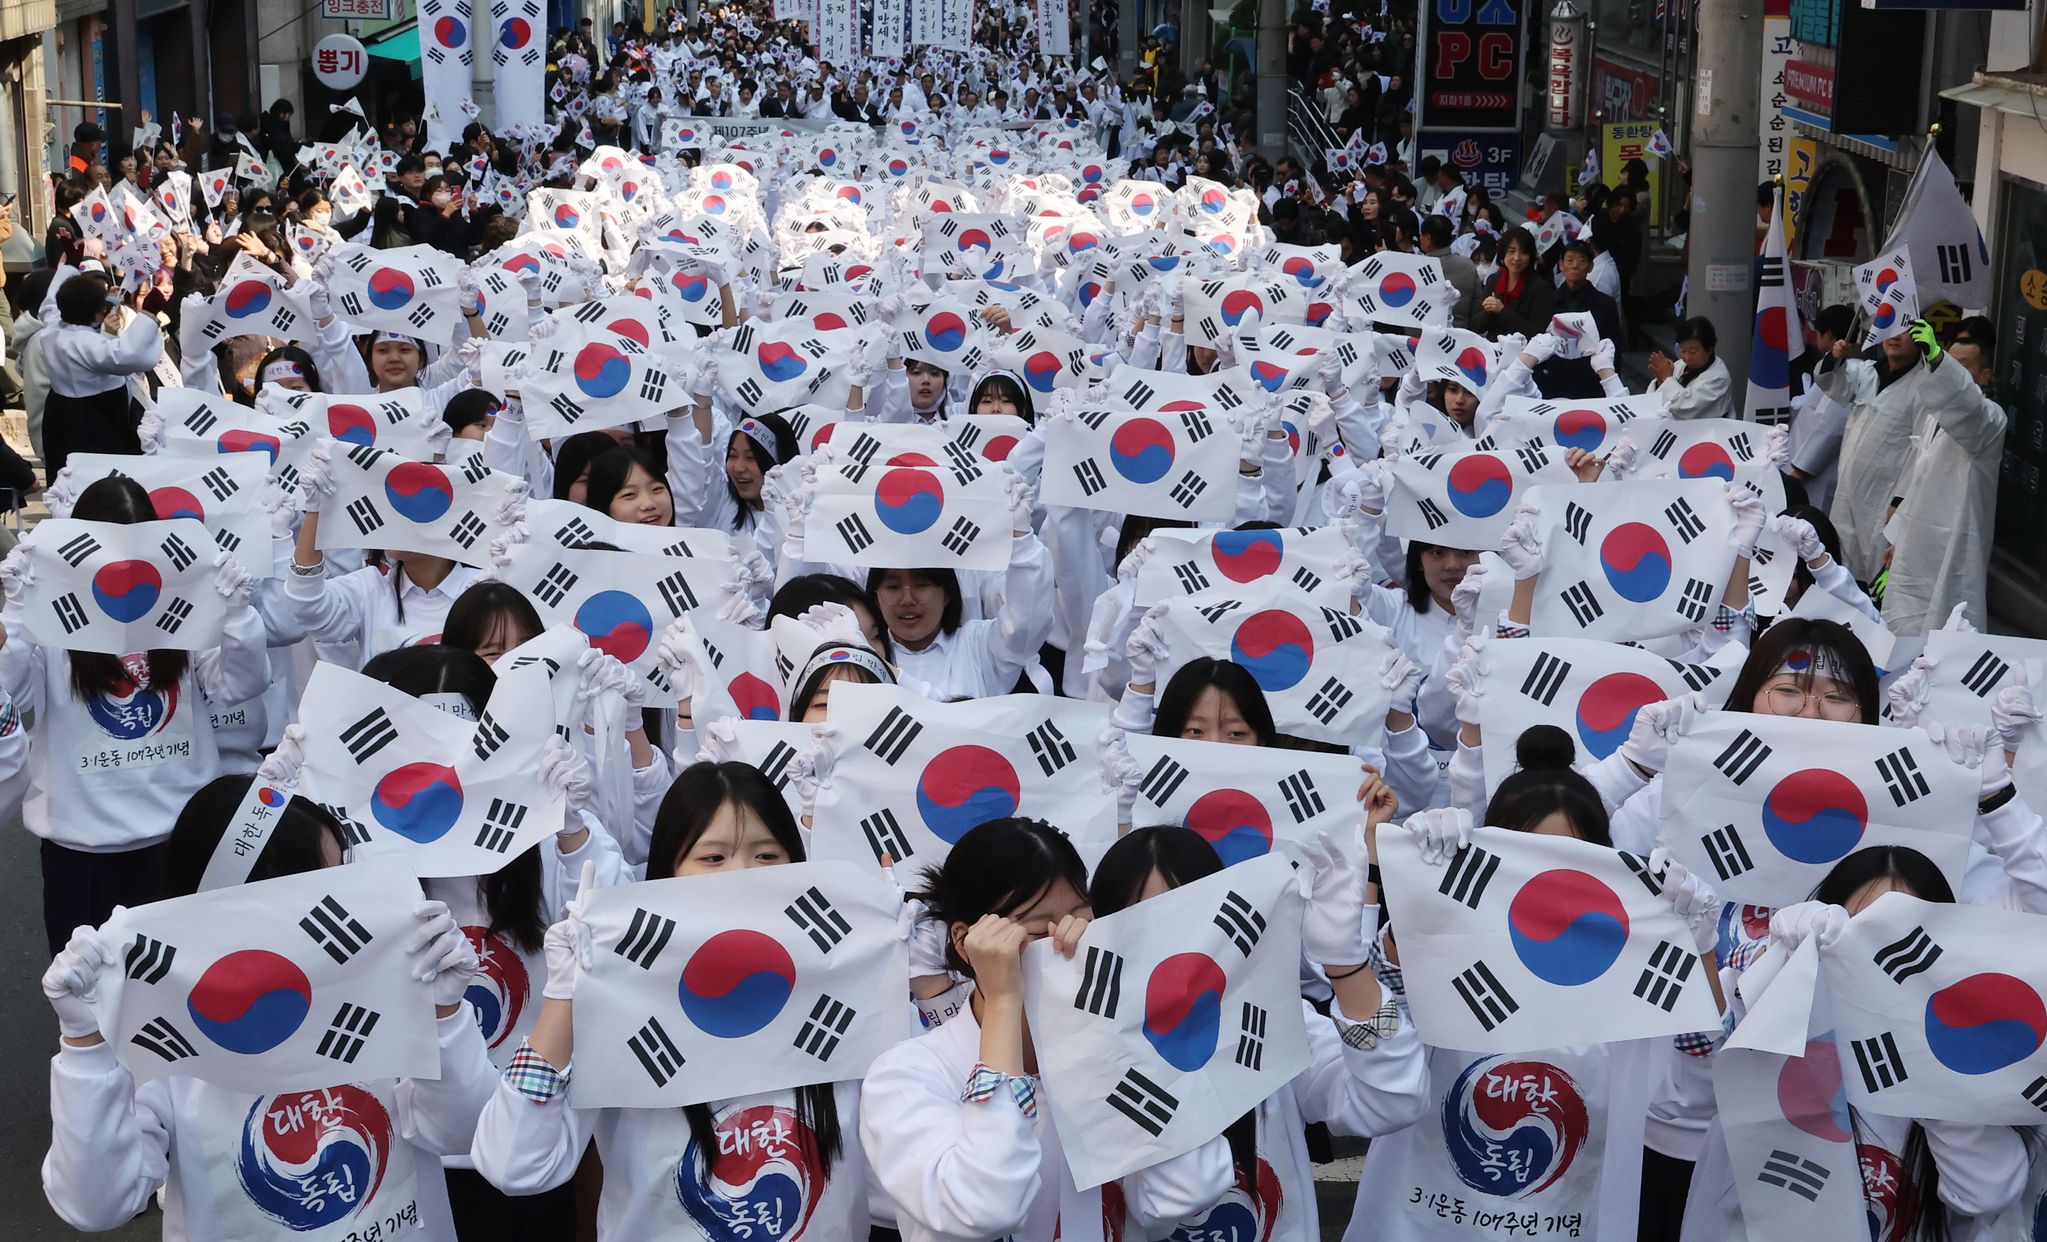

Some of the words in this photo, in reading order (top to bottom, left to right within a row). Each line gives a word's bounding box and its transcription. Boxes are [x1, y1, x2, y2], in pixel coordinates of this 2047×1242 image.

[328, 0, 384, 14] 잉크충전
[877, 13, 889, 50] 만세!
[317, 49, 360, 75] 뽑기
[1436, 31, 1513, 80] PC
[1551, 48, 1573, 127] 목욕합니다
[1787, 69, 1817, 95] PREMIUM
[1817, 76, 1827, 97] PC
[1439, 94, 1472, 106] 지하1층
[1611, 126, 1653, 140] 동환탕
[1487, 147, 1512, 163] 3F
[127, 656, 150, 684] 한
[120, 703, 152, 731] 독립
[222, 710, 246, 726] 기념
[127, 743, 166, 763] 107주년
[167, 740, 190, 756] 기념
[234, 823, 263, 857] 대한
[1486, 1074, 1565, 1115] 대한
[267, 1088, 360, 1136] 대한
[715, 1118, 802, 1157] 대한
[1480, 1140, 1534, 1183] 독립
[300, 1164, 356, 1213] 독립
[386, 1199, 418, 1233] 기념
[727, 1197, 783, 1239] 독립
[1473, 1210, 1539, 1237] 107주년
[1544, 1212, 1583, 1238] 기념
